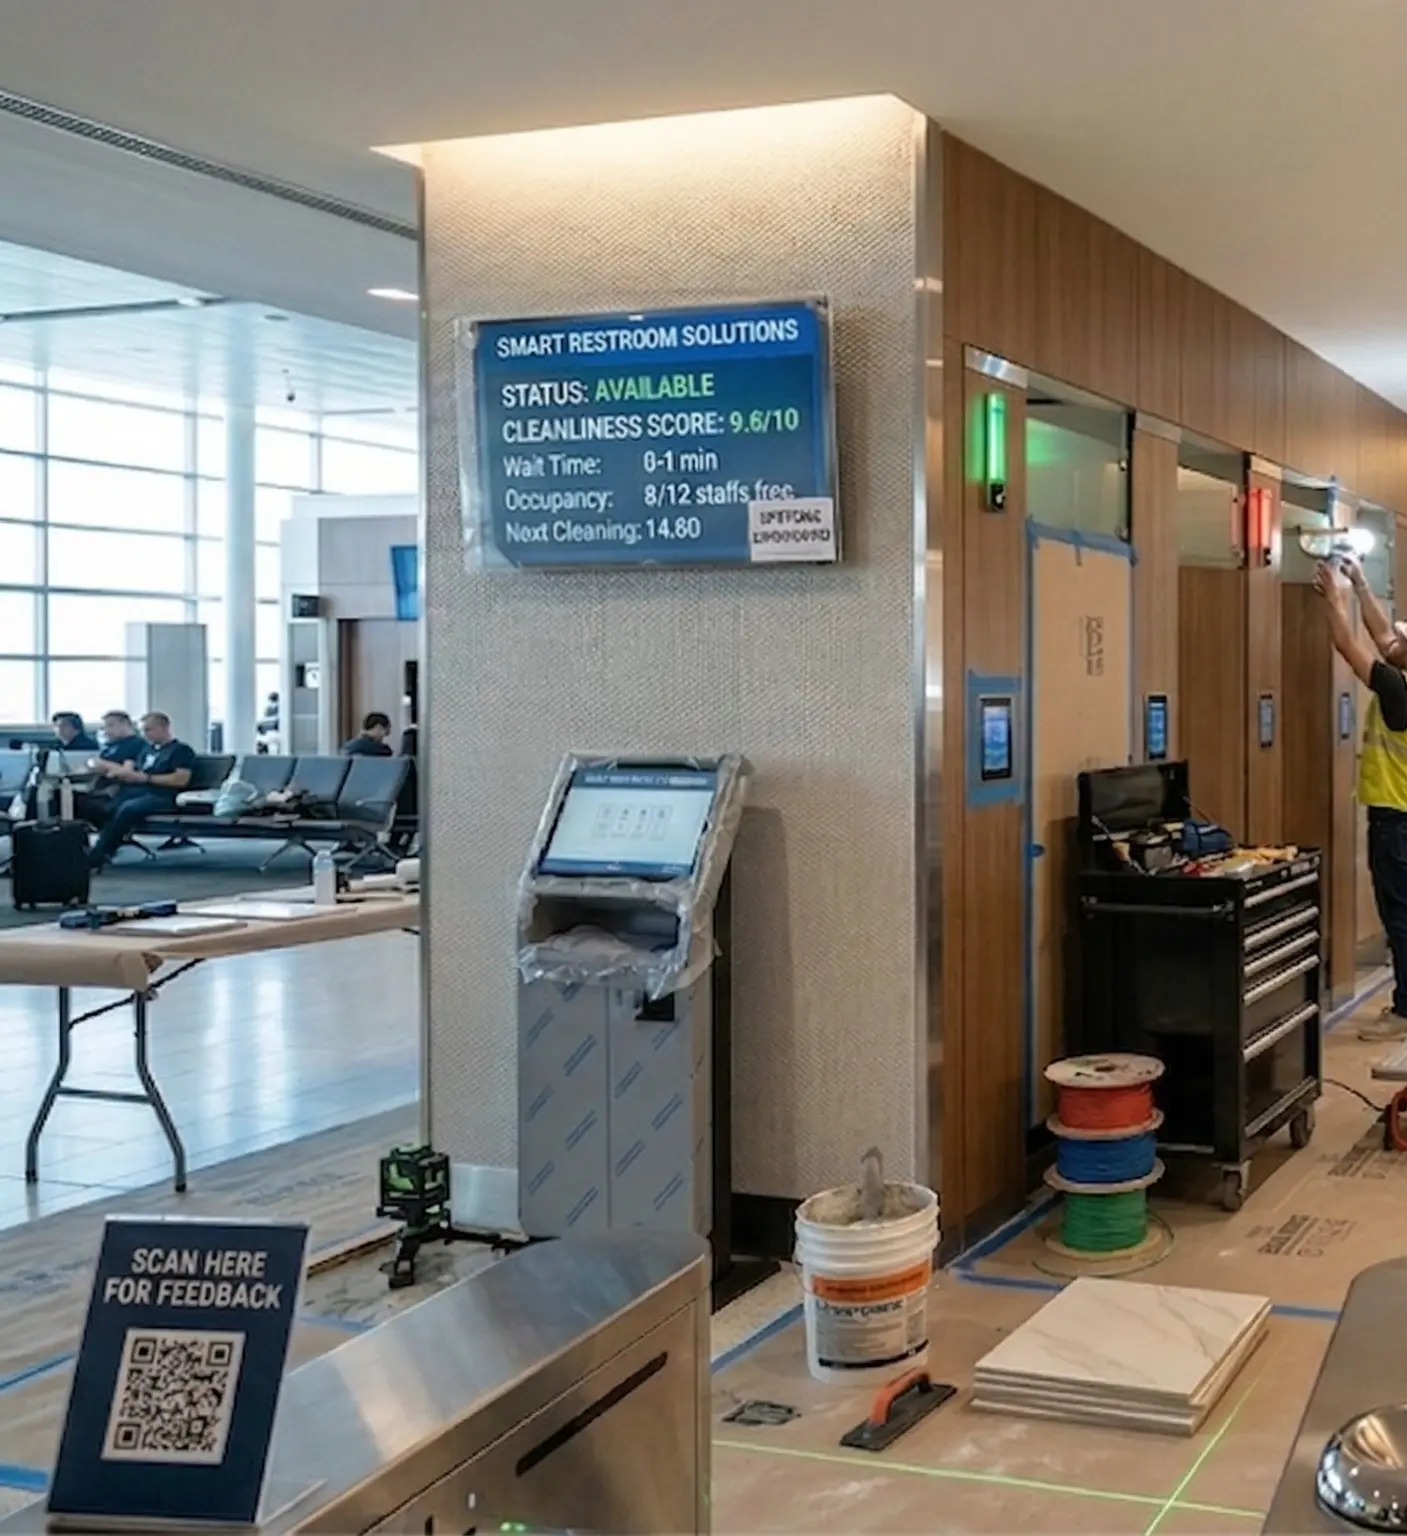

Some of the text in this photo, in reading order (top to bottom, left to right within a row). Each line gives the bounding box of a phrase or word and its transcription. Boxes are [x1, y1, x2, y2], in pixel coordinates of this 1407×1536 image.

[496, 318, 799, 358] SMART RESTROOM SOLUTIONS
[502, 373, 715, 408] STATUS: AVAILABLE
[502, 407, 799, 443] CLEANLINESS SCORE: 9.6/10
[548, 454, 602, 476] Time:
[679, 446, 719, 472] min
[505, 488, 614, 513] Occupancy:
[644, 482, 691, 508] 8/12
[553, 517, 642, 545] Cleaning:
[131, 1248, 268, 1277] SCAN HERE
[104, 1276, 283, 1309] FOR FEEDBACK
